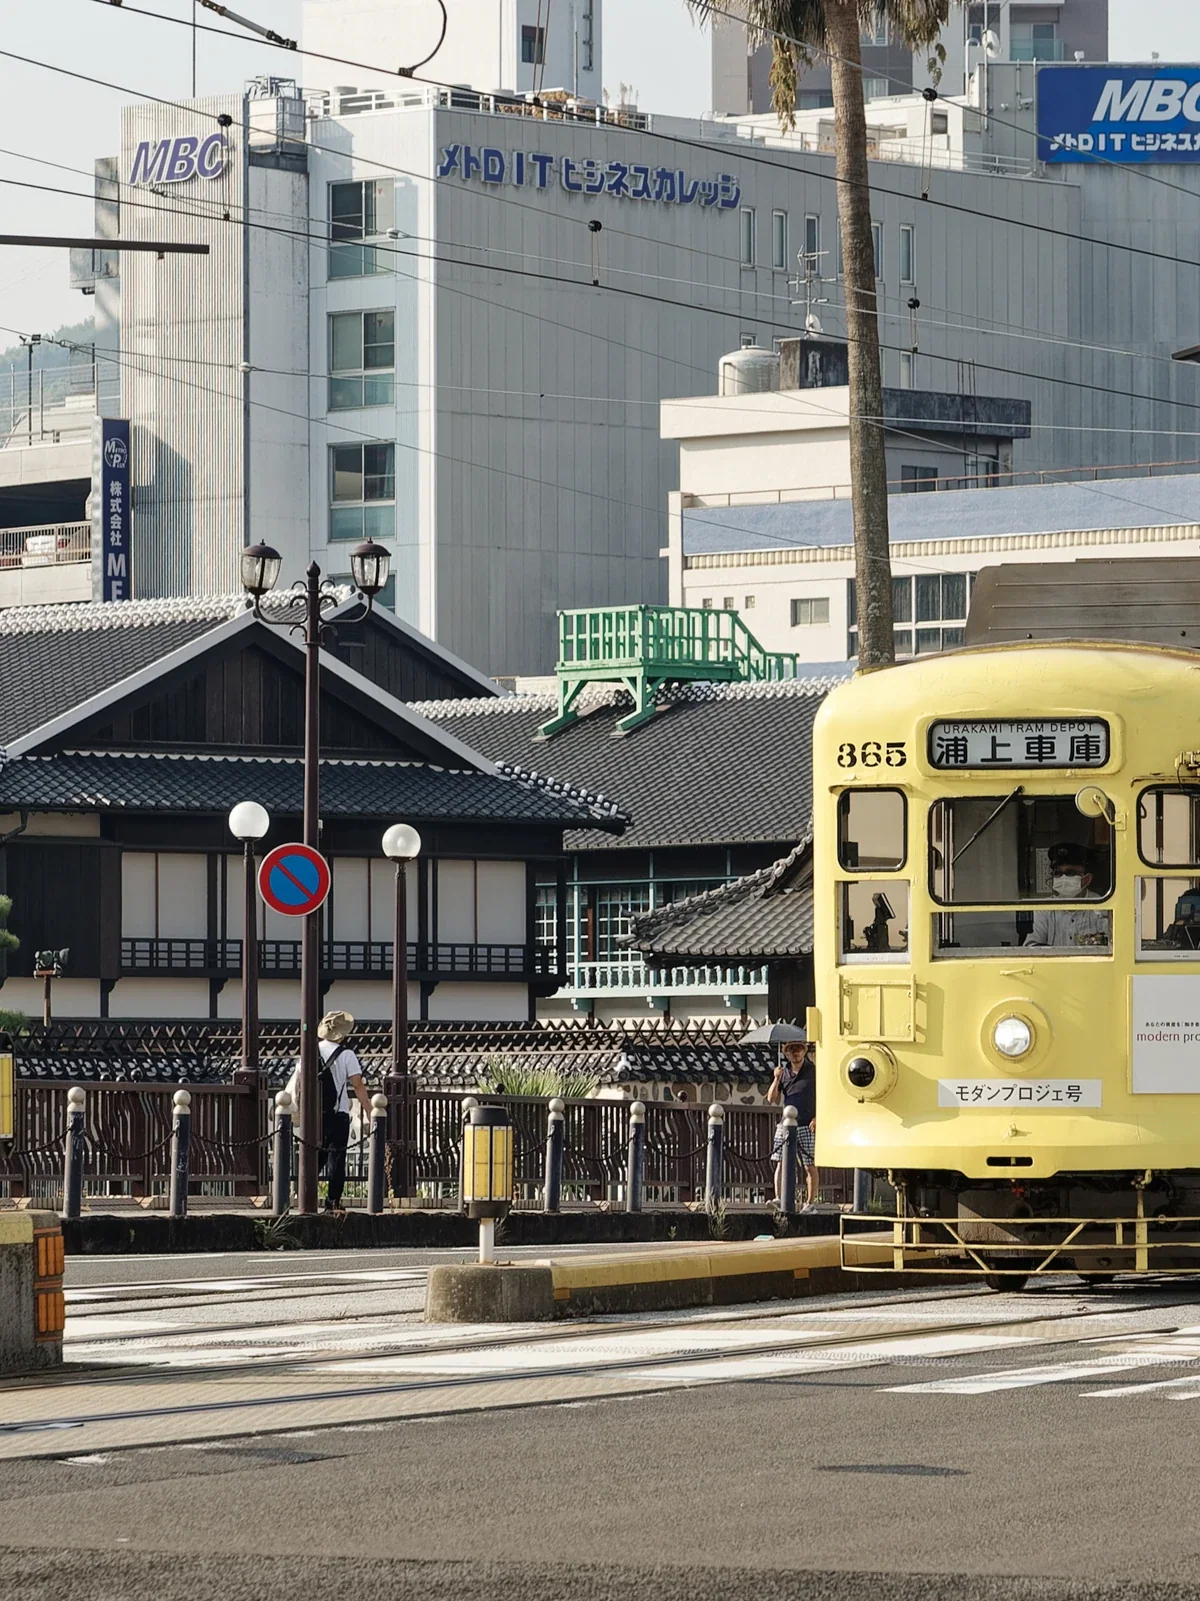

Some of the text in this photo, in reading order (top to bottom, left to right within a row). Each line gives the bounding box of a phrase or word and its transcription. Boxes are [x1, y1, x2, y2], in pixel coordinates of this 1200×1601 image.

[1096, 133, 1126, 152] IT
[129, 132, 229, 186] MBC
[437, 143, 742, 209] メトロ IT ビジネスカレッジ
[109, 480, 122, 546] 株式会社
[943, 722, 1094, 734] URAKAMI TRAM DEPOT
[837, 741, 907, 768] 365
[936, 734, 1101, 765] 浦上車庫
[1136, 1031, 1180, 1042] modern
[956, 1083, 1083, 1103] モダンプロジェ号
